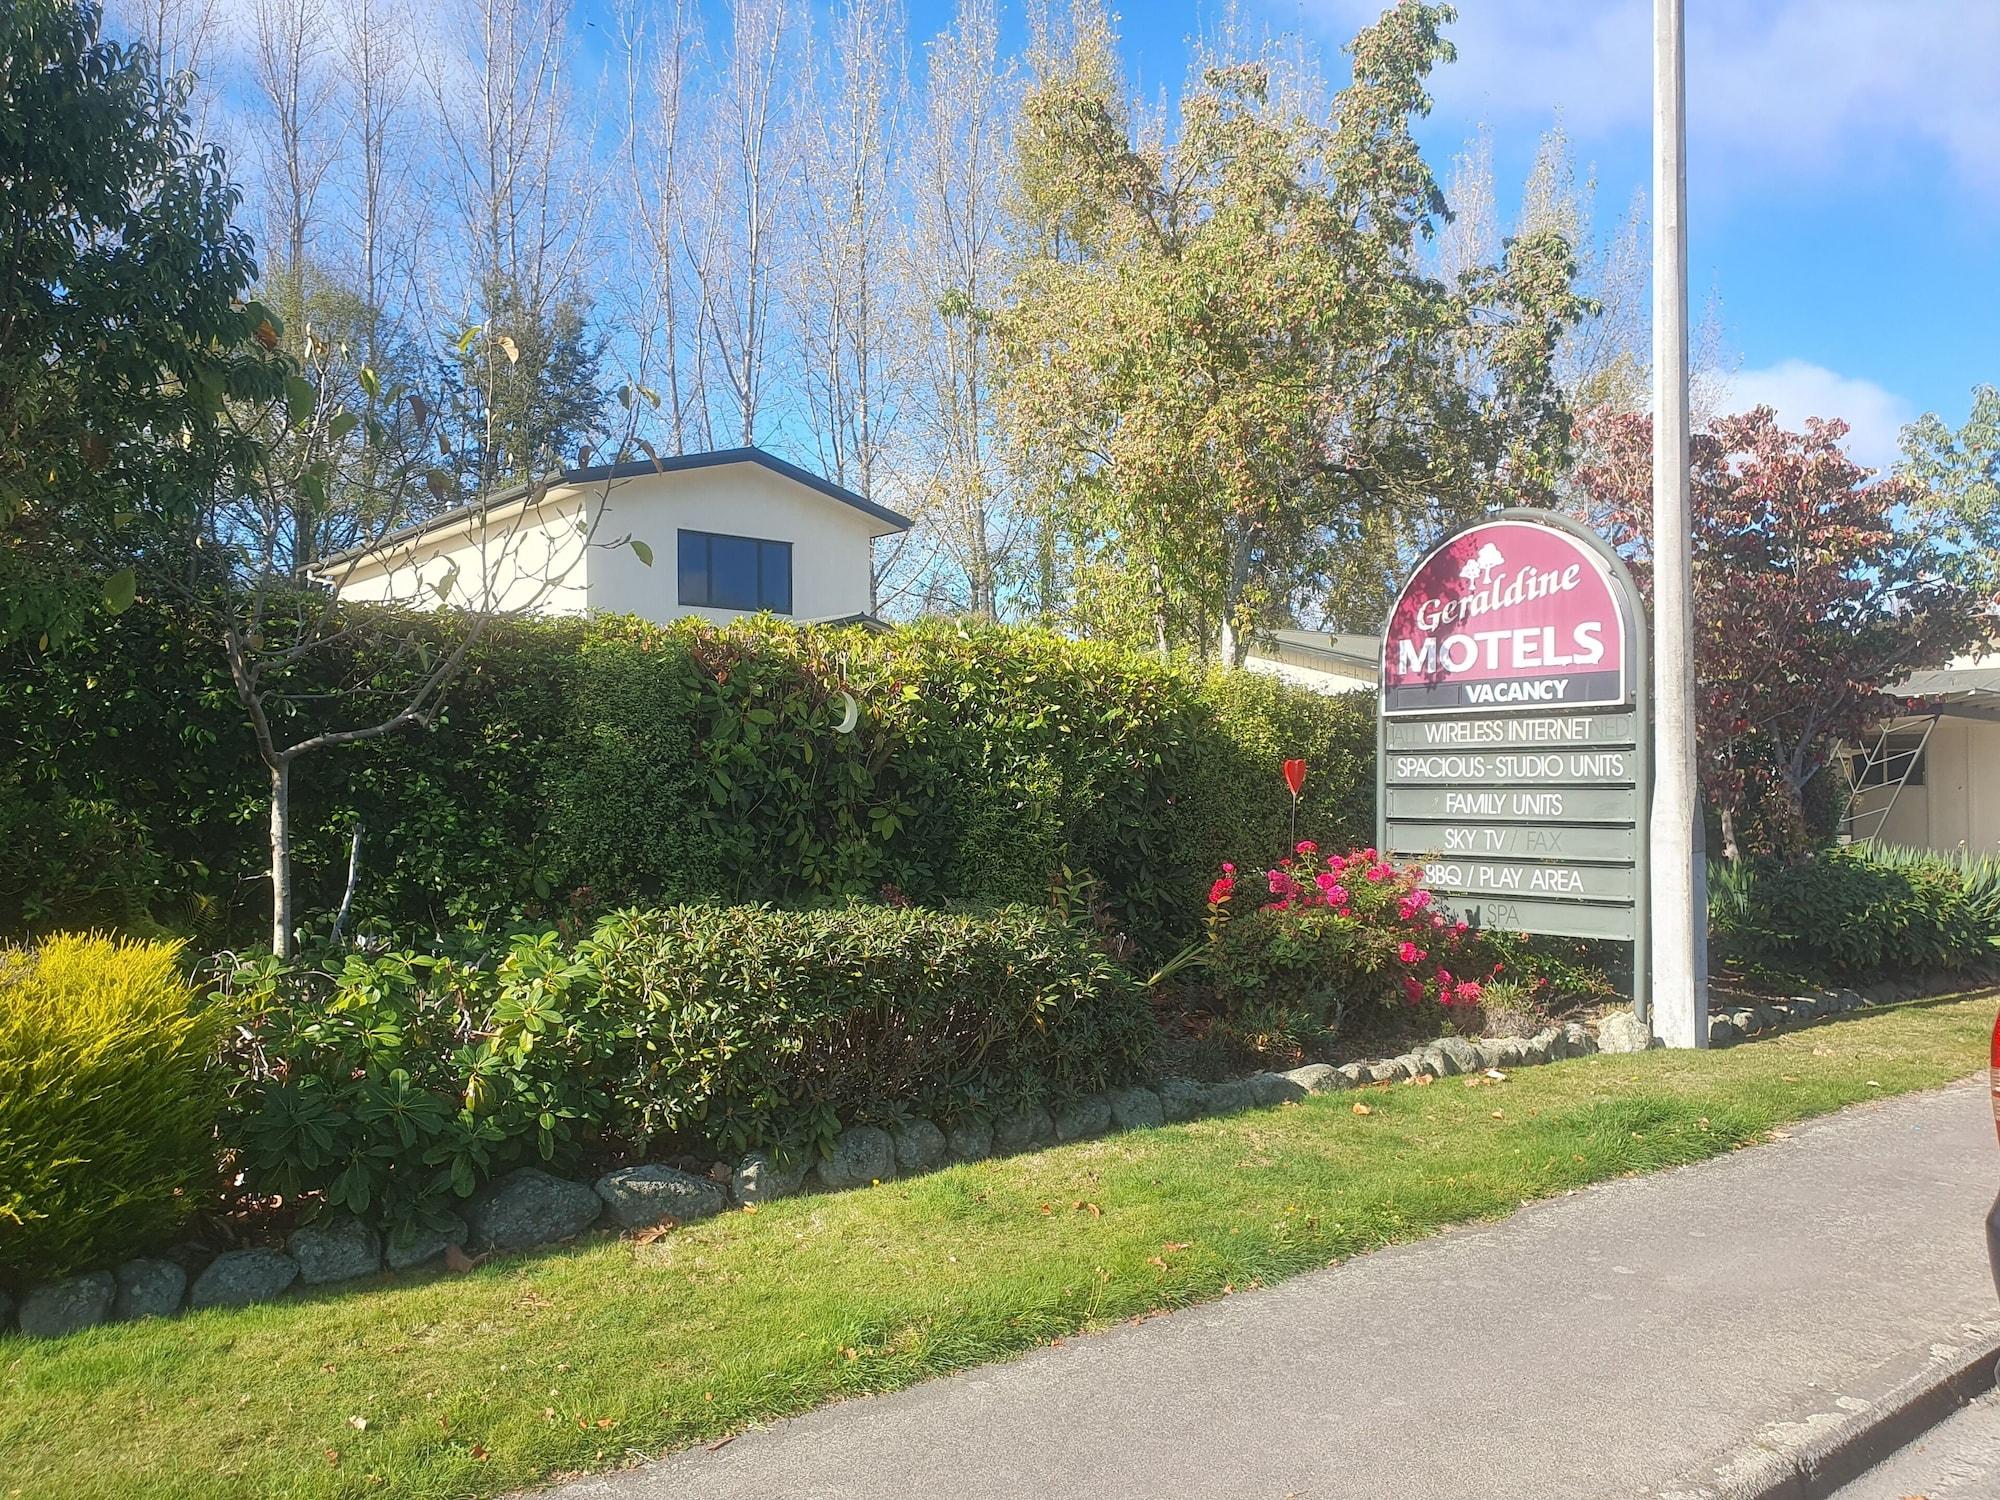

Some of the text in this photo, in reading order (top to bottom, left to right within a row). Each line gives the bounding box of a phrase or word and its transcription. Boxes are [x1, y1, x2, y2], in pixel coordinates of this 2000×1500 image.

[1417, 563, 1581, 632] Geraldine
[1399, 621, 1604, 675] MOTELS
[1465, 679, 1568, 703] VACANCY
[1425, 720, 1503, 743] WIRELESS
[1508, 718, 1592, 741] INTERNET
[1570, 753, 1624, 777] UNITS
[1446, 793, 1562, 816] FAMILY UNITS
[1444, 829, 1476, 851] SKY
[1483, 829, 1506, 851] TV
[1526, 832, 1562, 851] FAX
[1425, 864, 1462, 886] BBQ
[1479, 866, 1523, 889] PLAY
[1529, 869, 1584, 892] AREA
[1487, 903, 1520, 925] SPA
